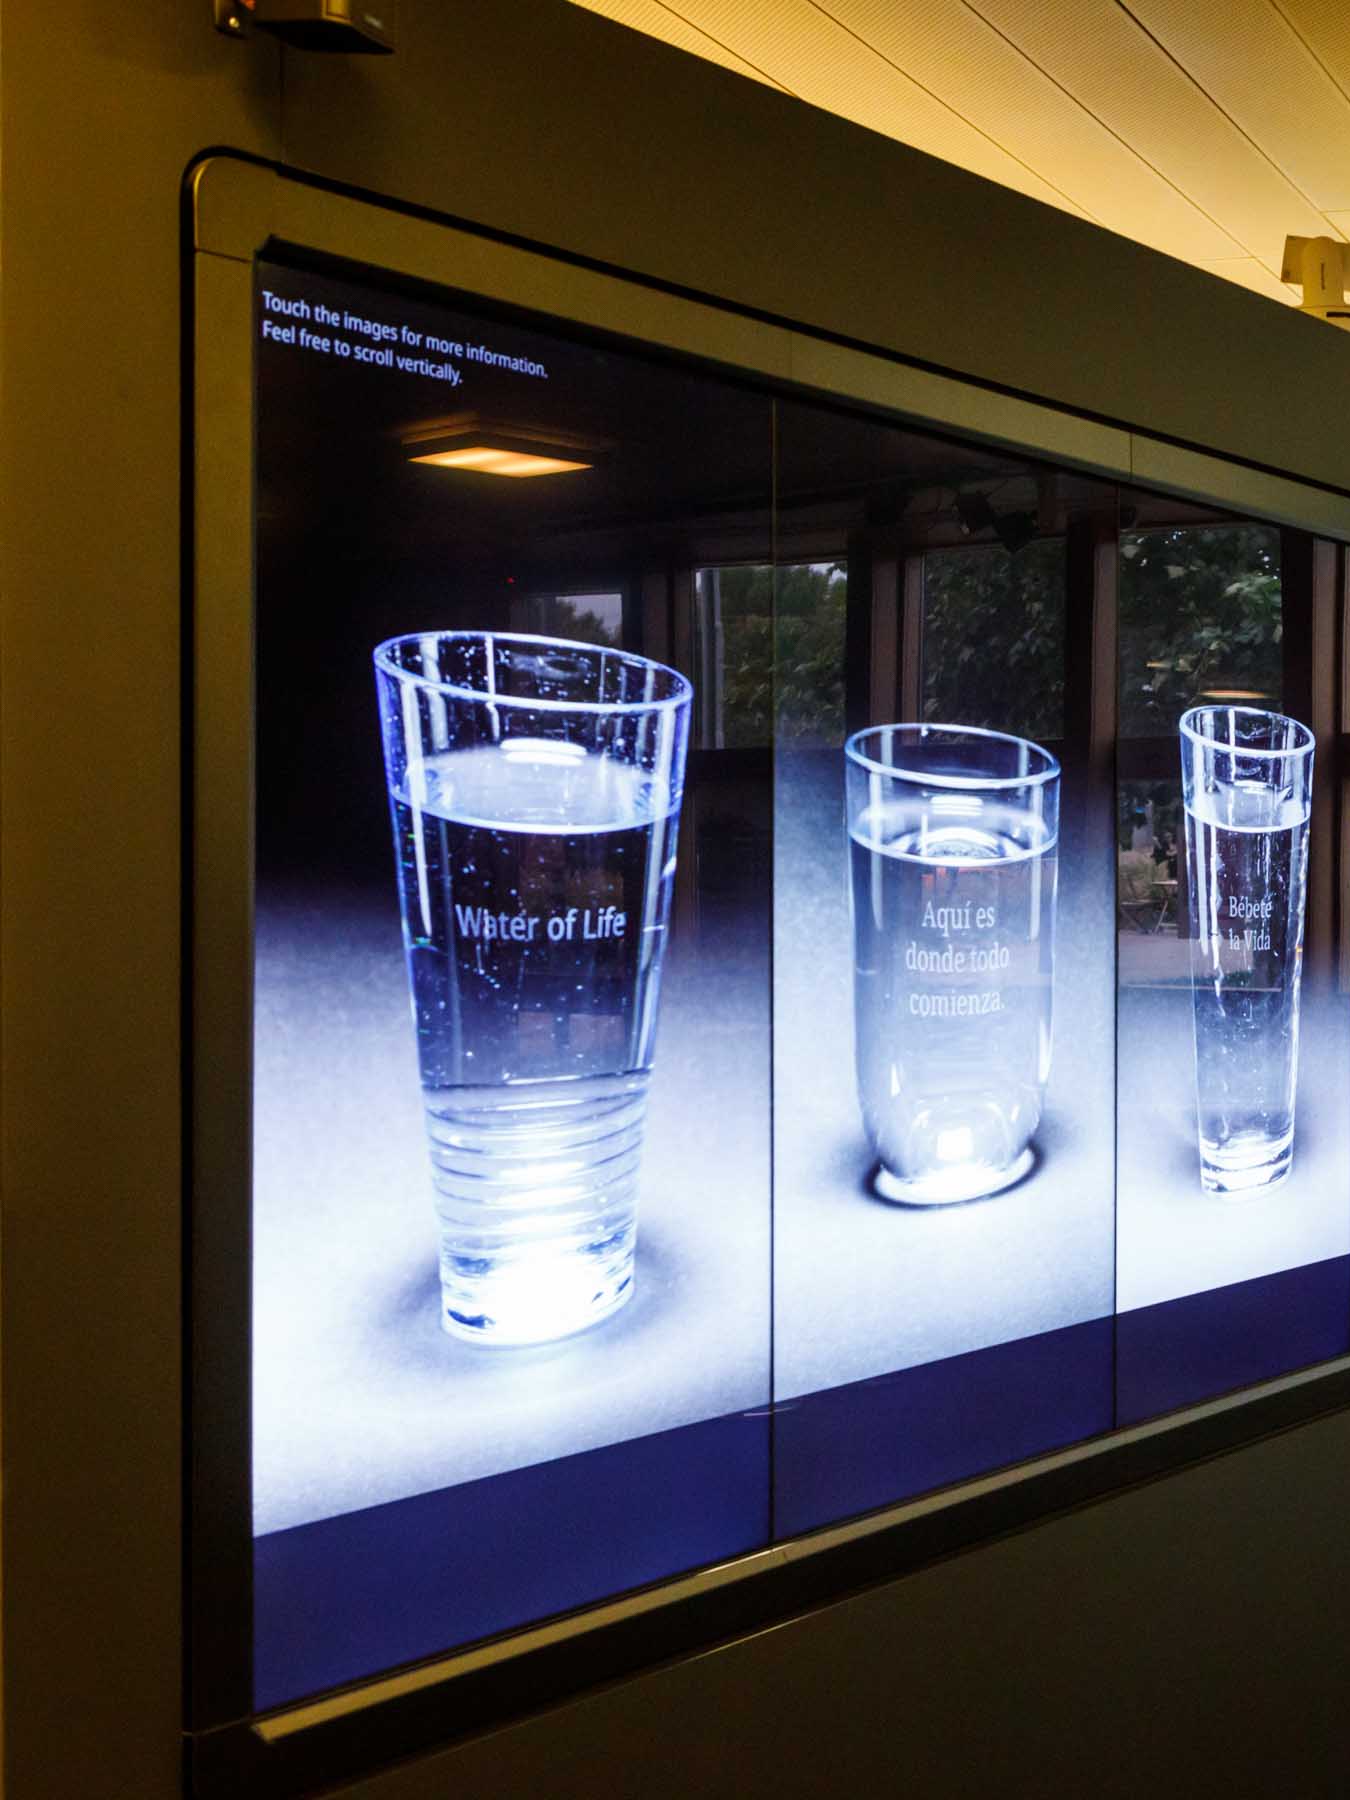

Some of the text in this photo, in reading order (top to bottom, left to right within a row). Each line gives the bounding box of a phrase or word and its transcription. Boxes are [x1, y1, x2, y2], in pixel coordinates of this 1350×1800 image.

[262, 290, 549, 379] Touch the images for more information.
[262, 320, 464, 387] Feel free to scroll vertically.
[455, 903, 627, 942] Water of Life
[921, 900, 996, 938] Aquí es
[906, 941, 1010, 974] donde todo
[1228, 927, 1271, 951] la Vida
[909, 988, 1005, 1017] comienza.
